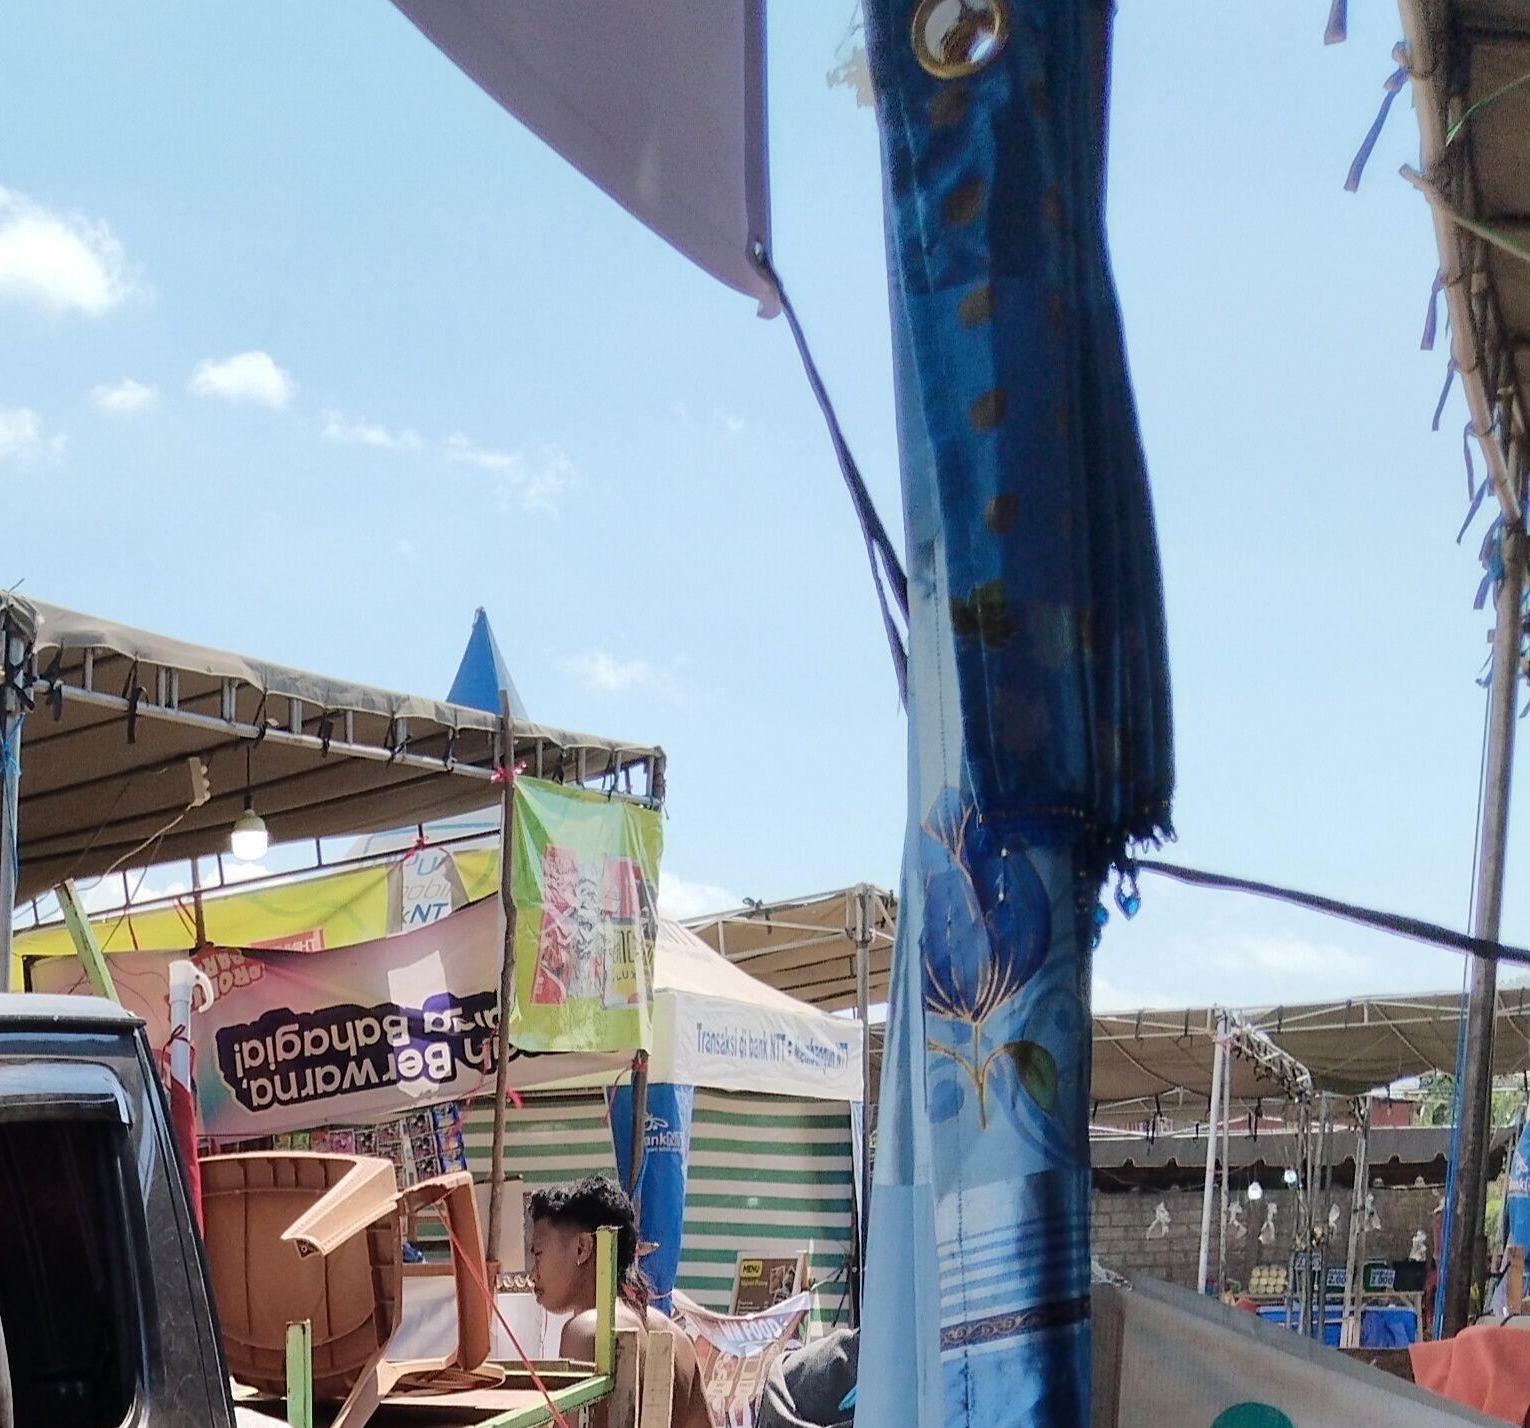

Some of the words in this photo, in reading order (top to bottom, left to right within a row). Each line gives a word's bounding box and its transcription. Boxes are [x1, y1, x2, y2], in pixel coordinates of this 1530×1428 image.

[233, 1015, 410, 1078] Bahagia!
[696, 1022, 737, 1057] Transaksi
[739, 1029, 747, 1058] di
[749, 1029, 769, 1060] bank
[770, 1032, 786, 1062] NTT
[241, 1041, 452, 1107] Berwarna,
[743, 1264, 760, 1274] MENU
[740, 1318, 782, 1341] FOOD
